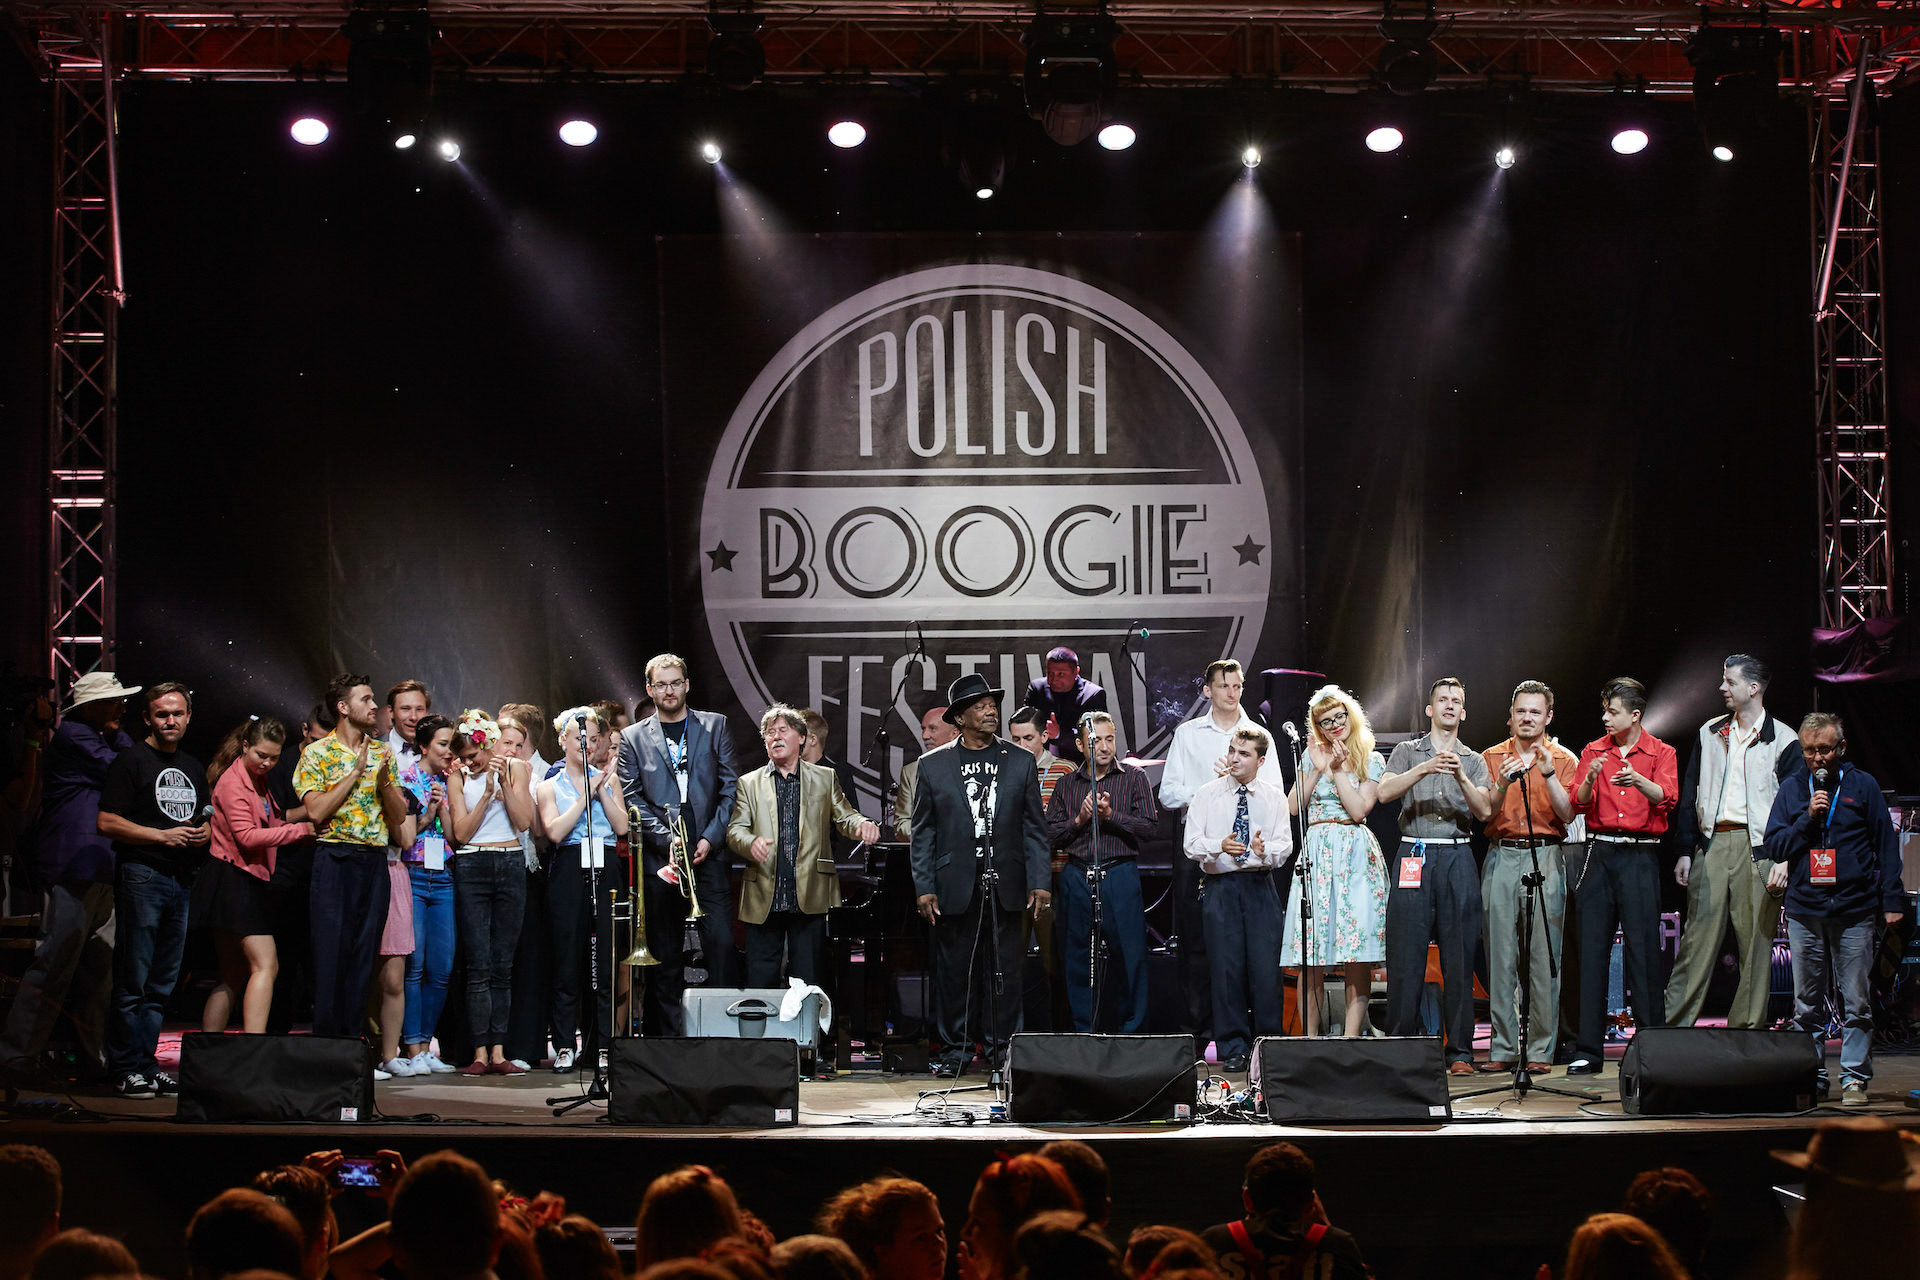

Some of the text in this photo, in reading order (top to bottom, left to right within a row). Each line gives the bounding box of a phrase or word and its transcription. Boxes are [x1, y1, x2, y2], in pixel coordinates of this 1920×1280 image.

[858, 309, 1107, 458] POLISH
[759, 503, 1211, 600] BOOGIE
[807, 652, 1168, 782] FESIAL
[960, 761, 981, 776] RIS
[164, 771, 186, 787] POLISH
[160, 789, 194, 800] BOOGIE
[165, 802, 191, 818] FESTIVAL
